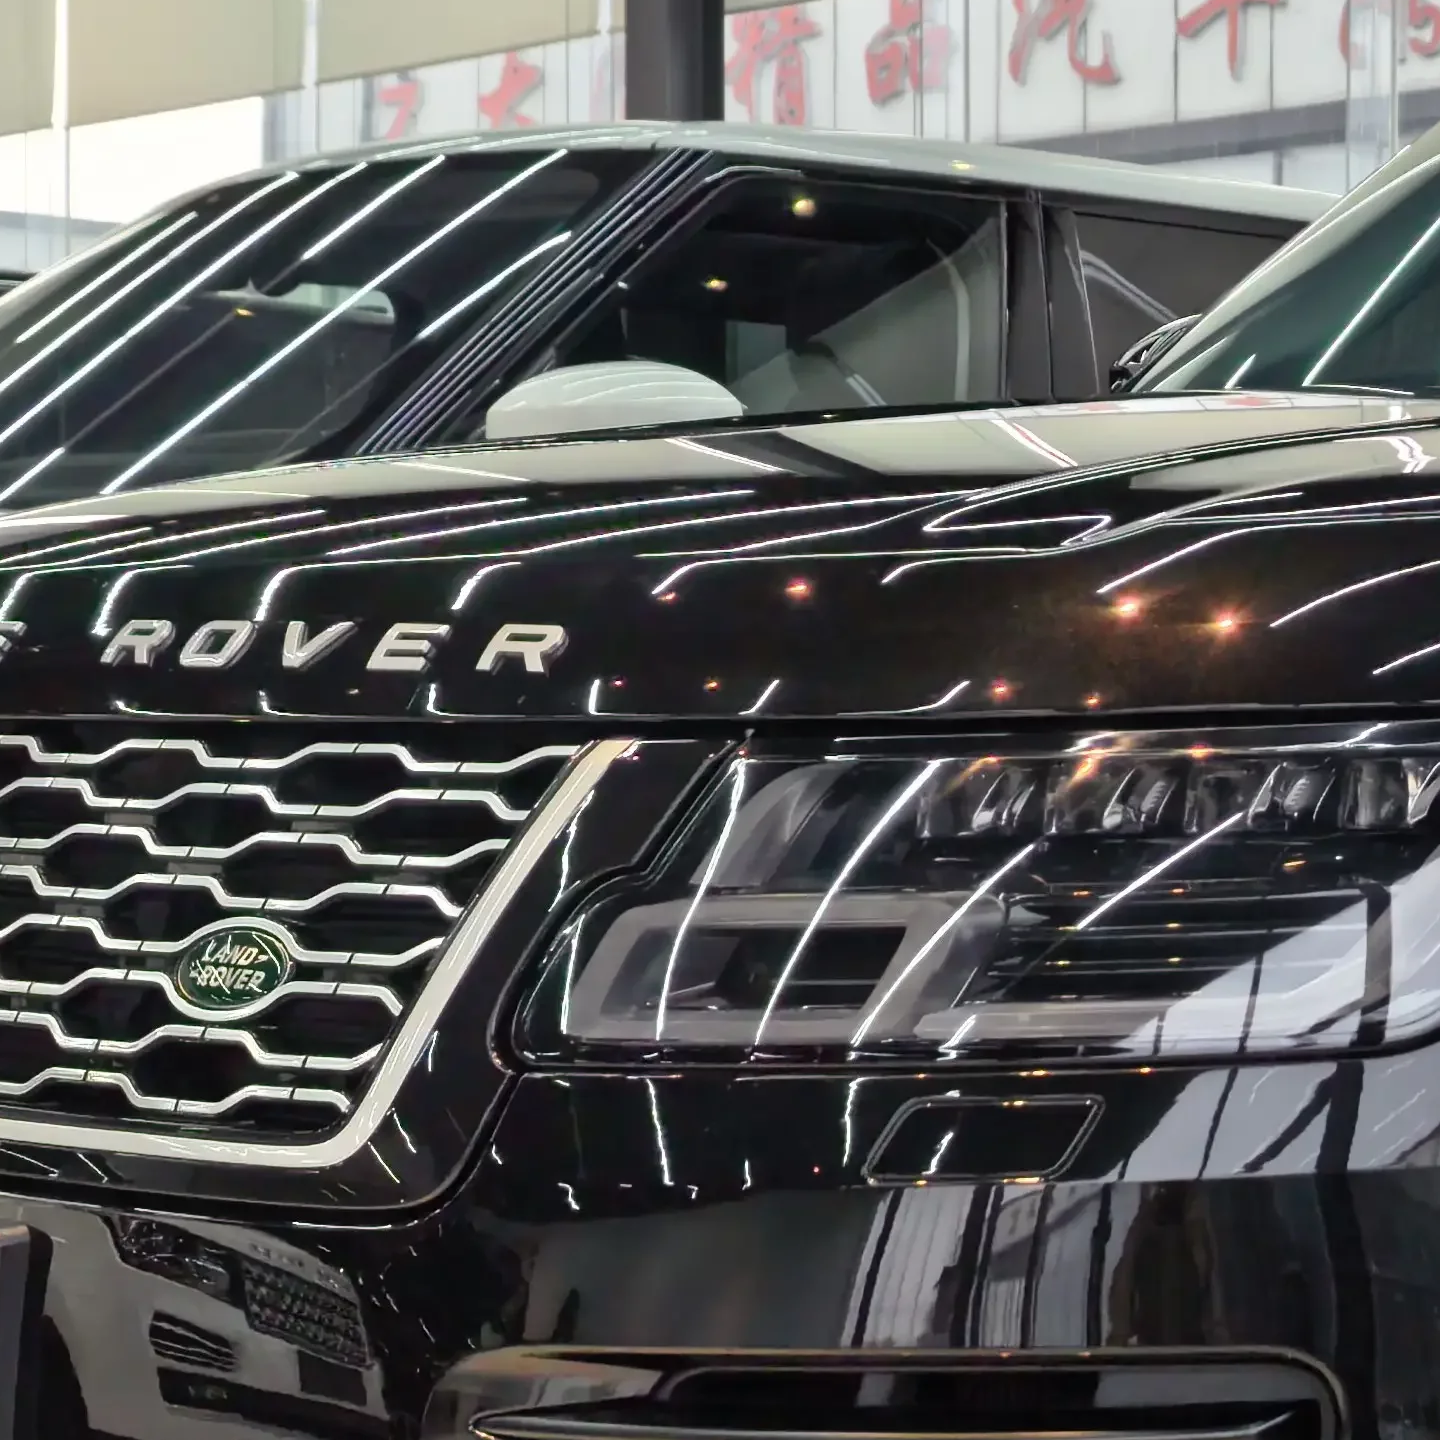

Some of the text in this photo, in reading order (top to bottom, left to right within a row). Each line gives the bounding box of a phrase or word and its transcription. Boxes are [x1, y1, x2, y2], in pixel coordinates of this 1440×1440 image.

[100, 618, 570, 674] ROVER
[201, 943, 259, 966] LAND
[197, 964, 266, 991] ROVER
